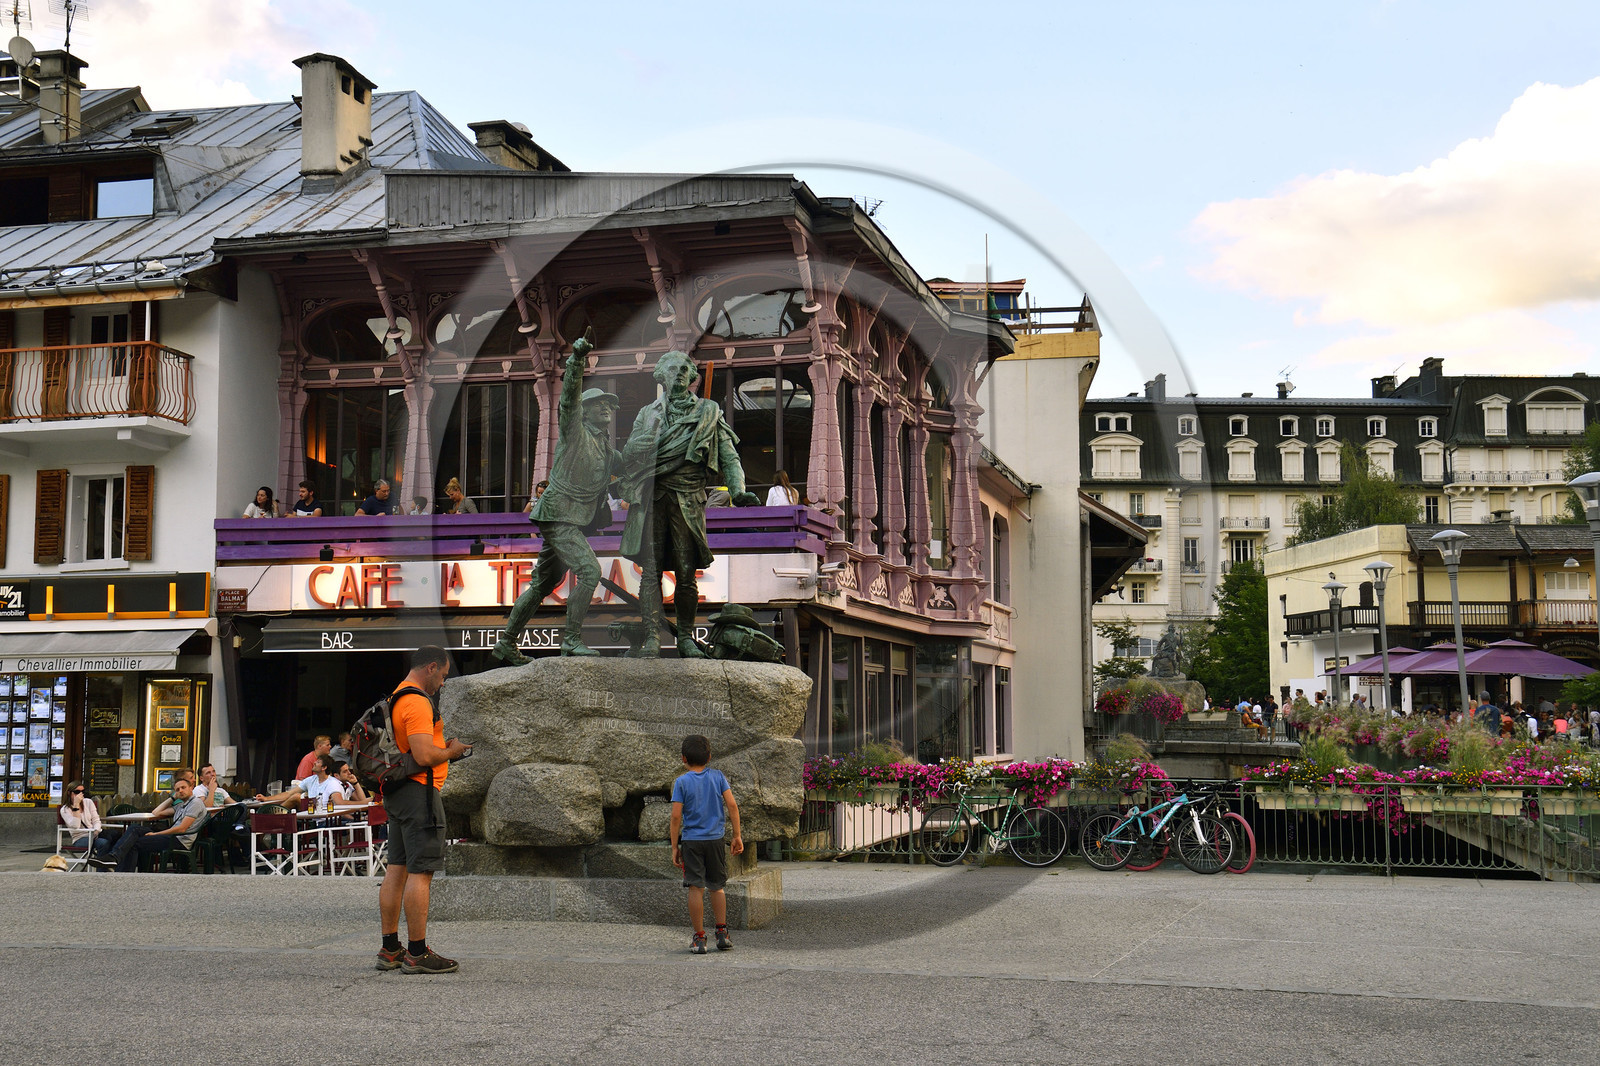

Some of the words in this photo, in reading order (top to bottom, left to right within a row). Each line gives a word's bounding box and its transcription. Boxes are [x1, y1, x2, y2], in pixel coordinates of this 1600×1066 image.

[308, 563, 405, 608] CAFE
[440, 562, 465, 607] LA
[321, 632, 354, 649] BAR
[478, 628, 560, 647] TEASSE
[1450, 636, 1491, 649] IOBILIER
[17, 658, 77, 671] Chevallier
[79, 657, 143, 670] Immobilier
[585, 718, 632, 732] CHAMOX
[17, 793, 52, 801] VACANCES
